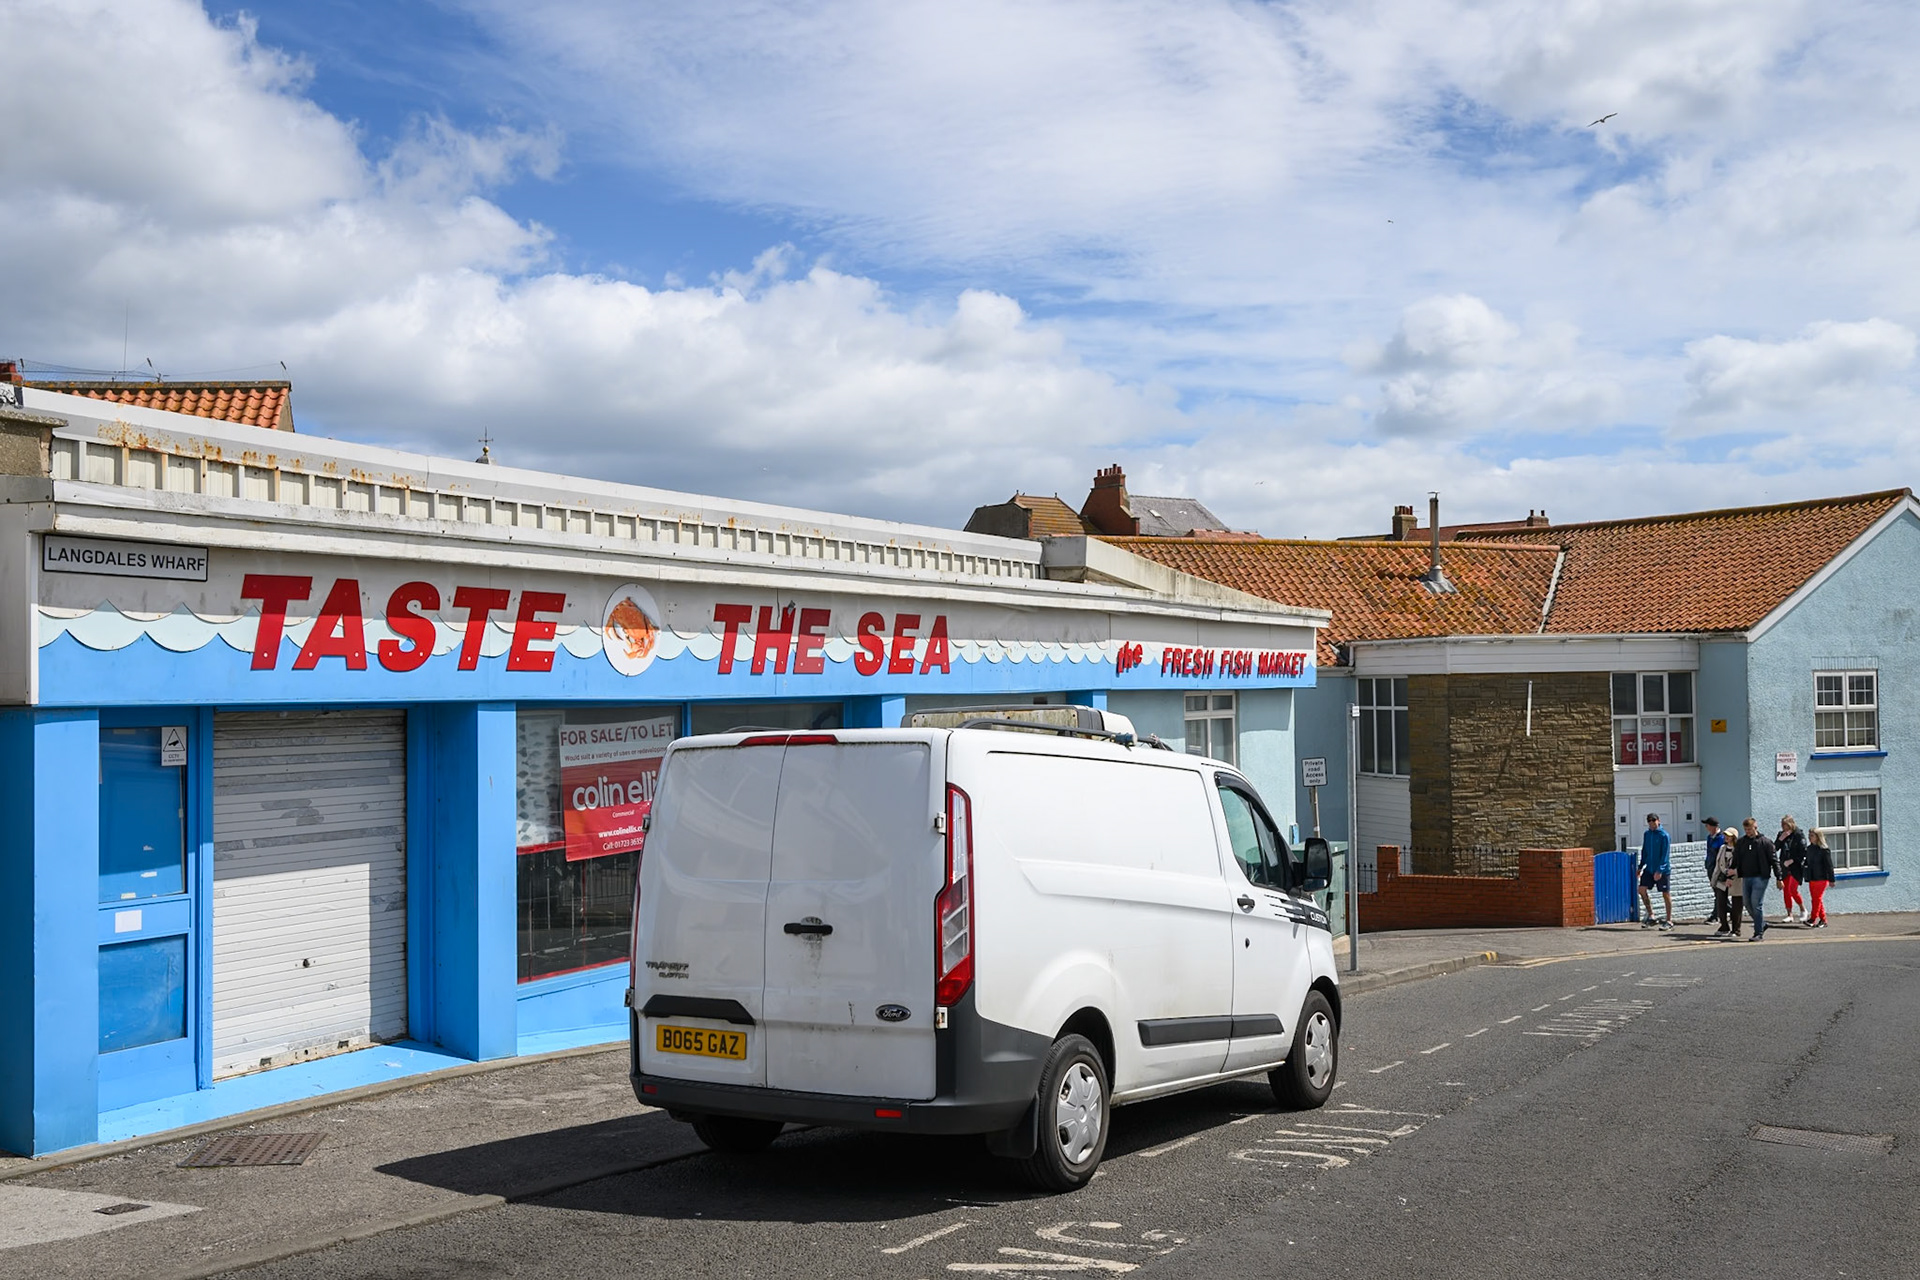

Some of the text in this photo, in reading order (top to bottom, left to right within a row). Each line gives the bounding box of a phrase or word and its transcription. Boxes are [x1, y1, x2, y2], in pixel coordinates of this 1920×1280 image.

[48, 547, 206, 571] LANGDALES WHARF
[241, 573, 567, 673] TASTE
[713, 603, 951, 676] THE SEA
[1117, 640, 1307, 676] the FRESH FISH MARKET
[560, 722, 673, 746] FOR SALE/TO LET
[564, 754, 580, 762] Would
[580, 753, 591, 761] suit
[595, 751, 613, 759] variety
[572, 770, 657, 811] colin elli
[612, 809, 635, 818] Commercial
[614, 839, 630, 849] 01723
[645, 960, 690, 971] TRANSIT
[658, 971, 690, 980] CUSTOM
[882, 1009, 903, 1018] Ford
[662, 1028, 739, 1056] BO65 GAZ
